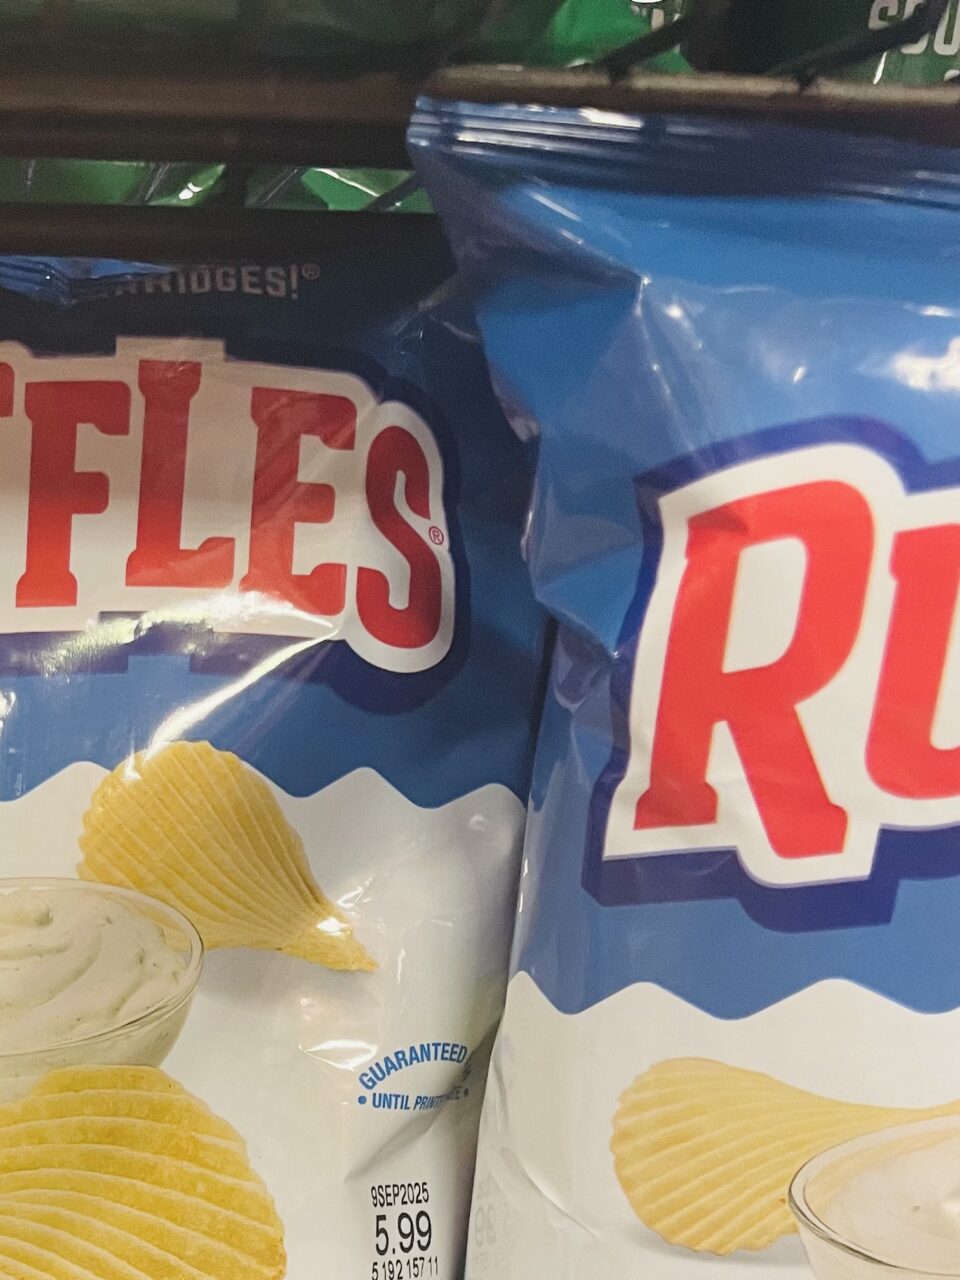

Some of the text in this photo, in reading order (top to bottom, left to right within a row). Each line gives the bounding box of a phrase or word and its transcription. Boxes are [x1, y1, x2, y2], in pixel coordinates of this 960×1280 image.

[358, 1042, 468, 1090] GUARANTEED
[372, 1093, 411, 1110] UNTIL
[370, 1181, 429, 1208] 9SEP2025
[375, 1210, 432, 1256] 5.99
